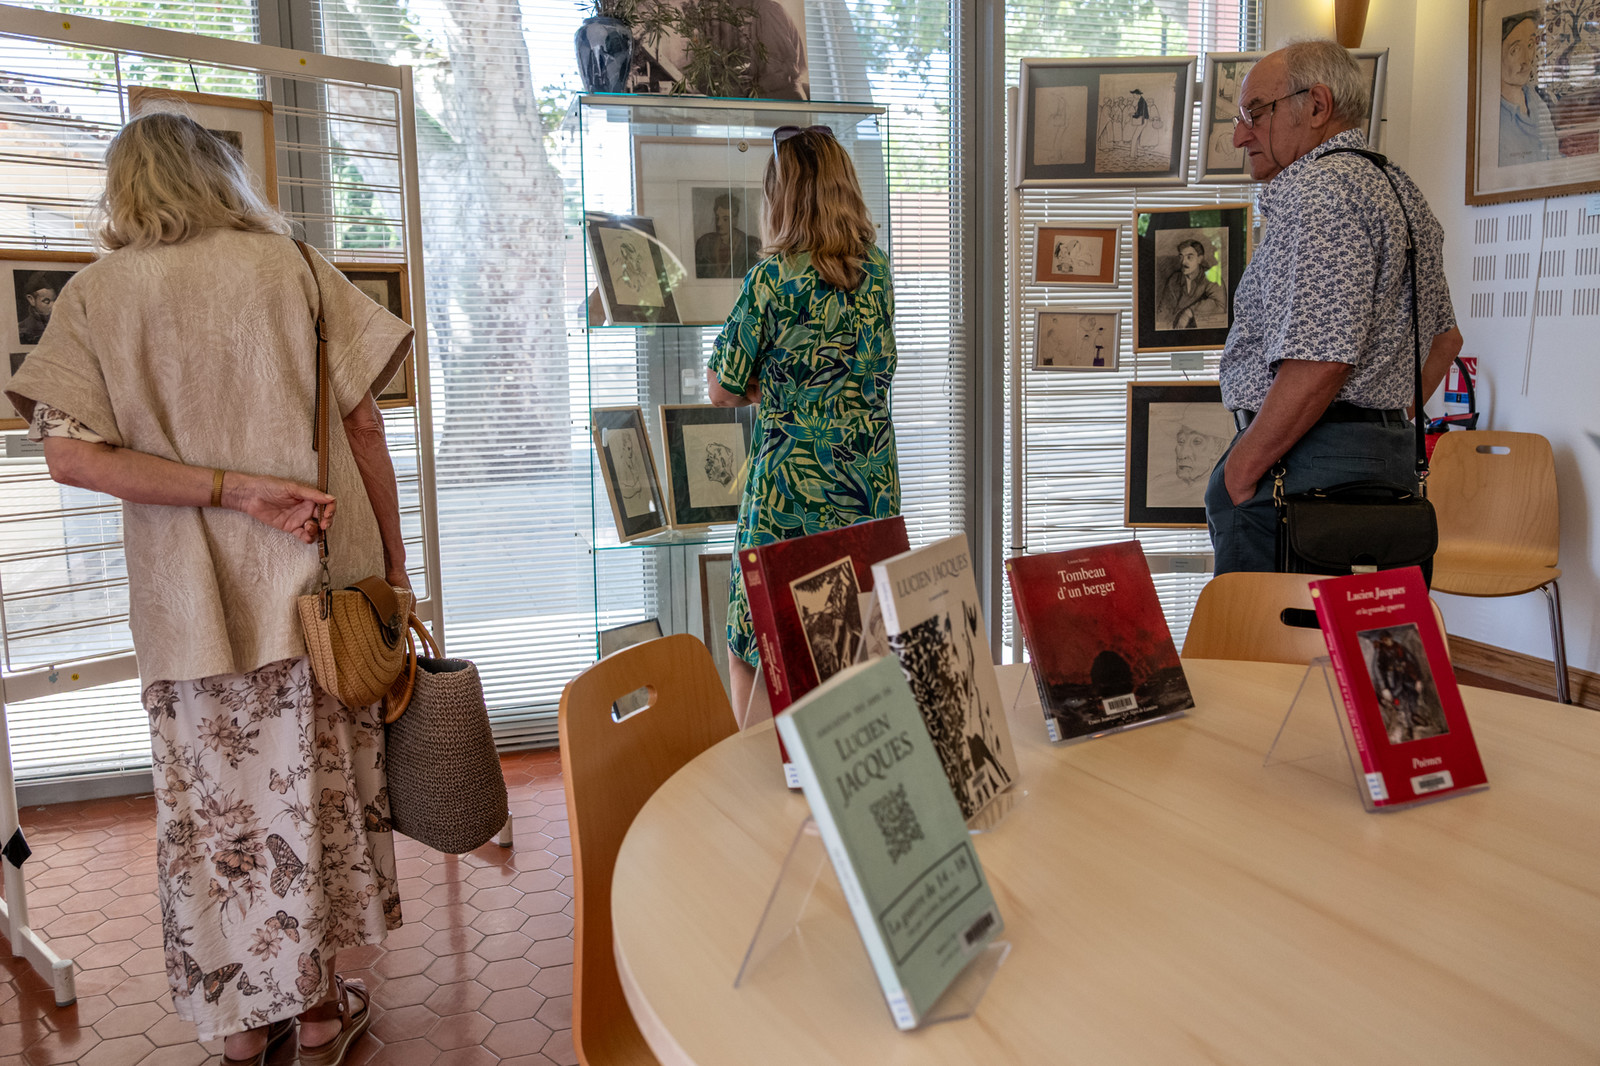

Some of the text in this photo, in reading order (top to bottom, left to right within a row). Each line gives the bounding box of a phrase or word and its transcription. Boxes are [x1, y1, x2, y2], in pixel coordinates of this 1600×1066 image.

[896, 568, 932, 598] LUCIEN
[931, 553, 968, 586] JACQUES
[1057, 567, 1106, 583] Tombeau
[1057, 582, 1115, 600] d'un berger
[1346, 586, 1405, 601] Lucien Jacques
[835, 712, 891, 762] LUCIEN
[836, 730, 914, 808] JACQUES
